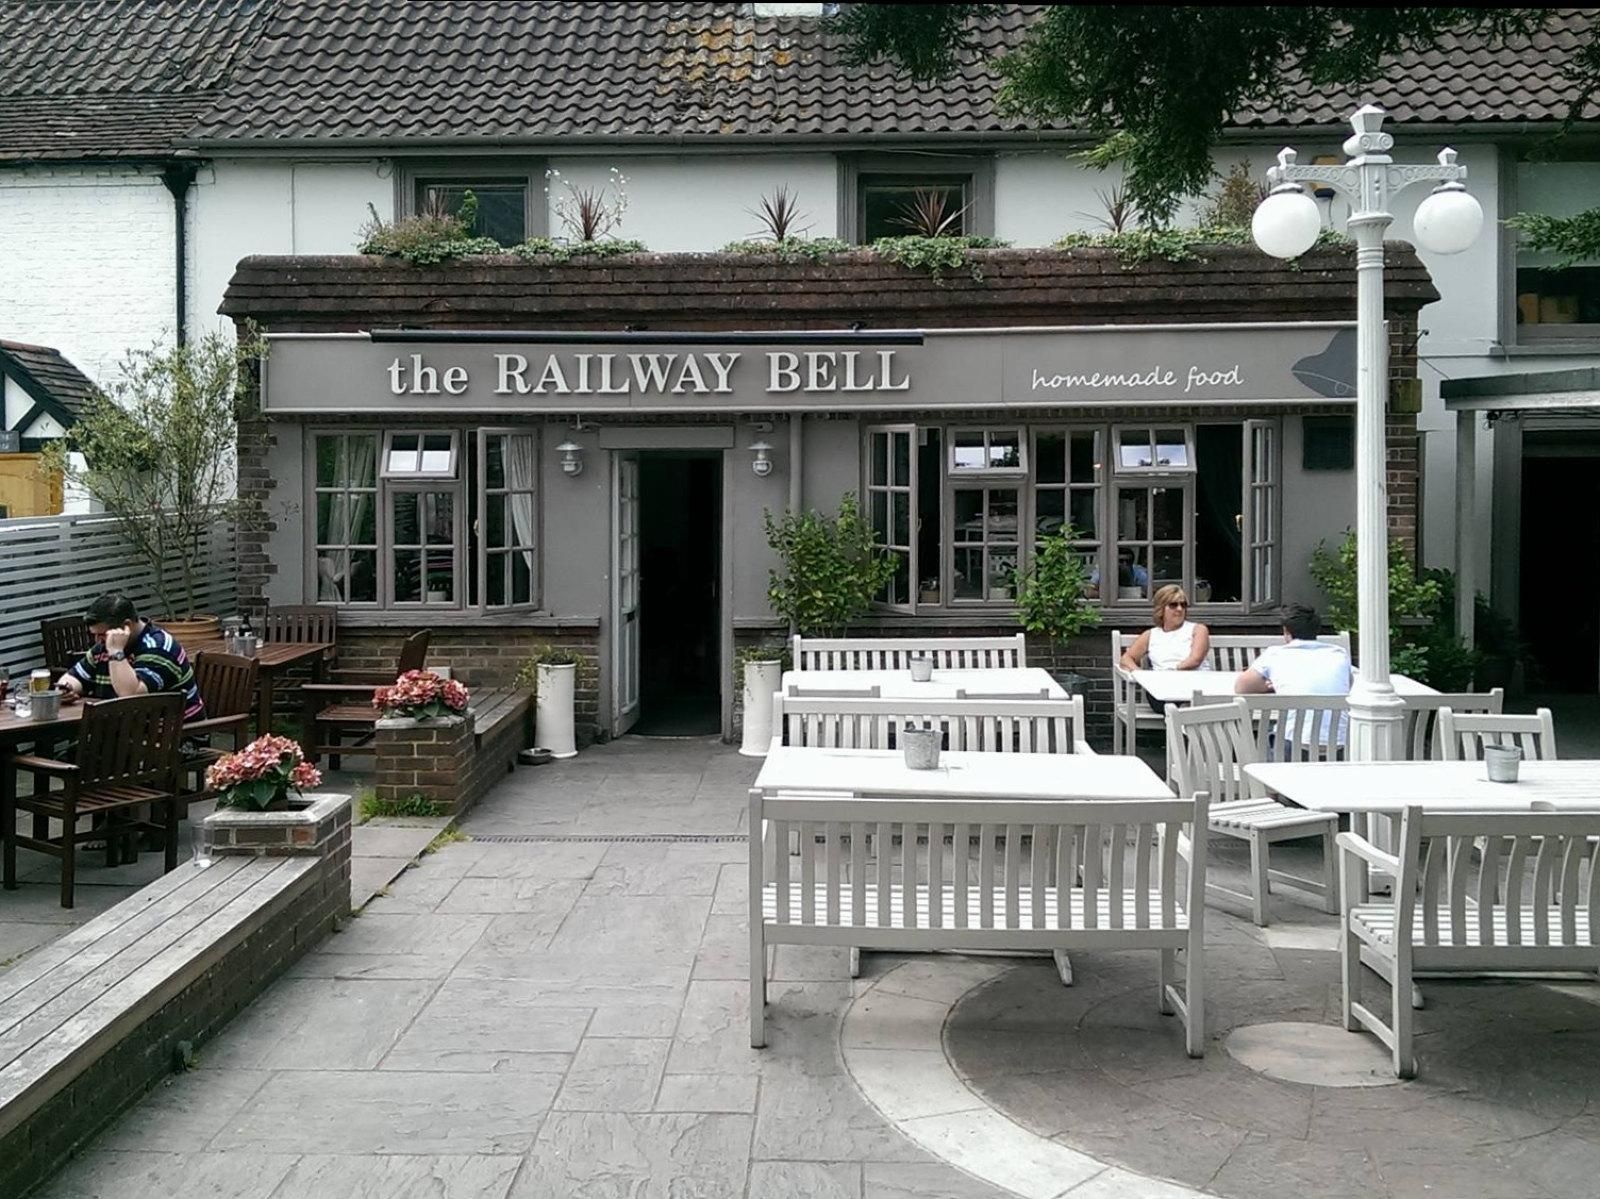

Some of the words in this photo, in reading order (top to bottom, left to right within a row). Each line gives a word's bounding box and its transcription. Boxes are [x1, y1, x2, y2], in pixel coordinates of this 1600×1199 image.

[388, 354, 469, 396] the
[494, 352, 741, 395] RAILWAY
[766, 350, 911, 393] BELL
[1032, 366, 1177, 390] homemade
[1185, 364, 1244, 392] food
